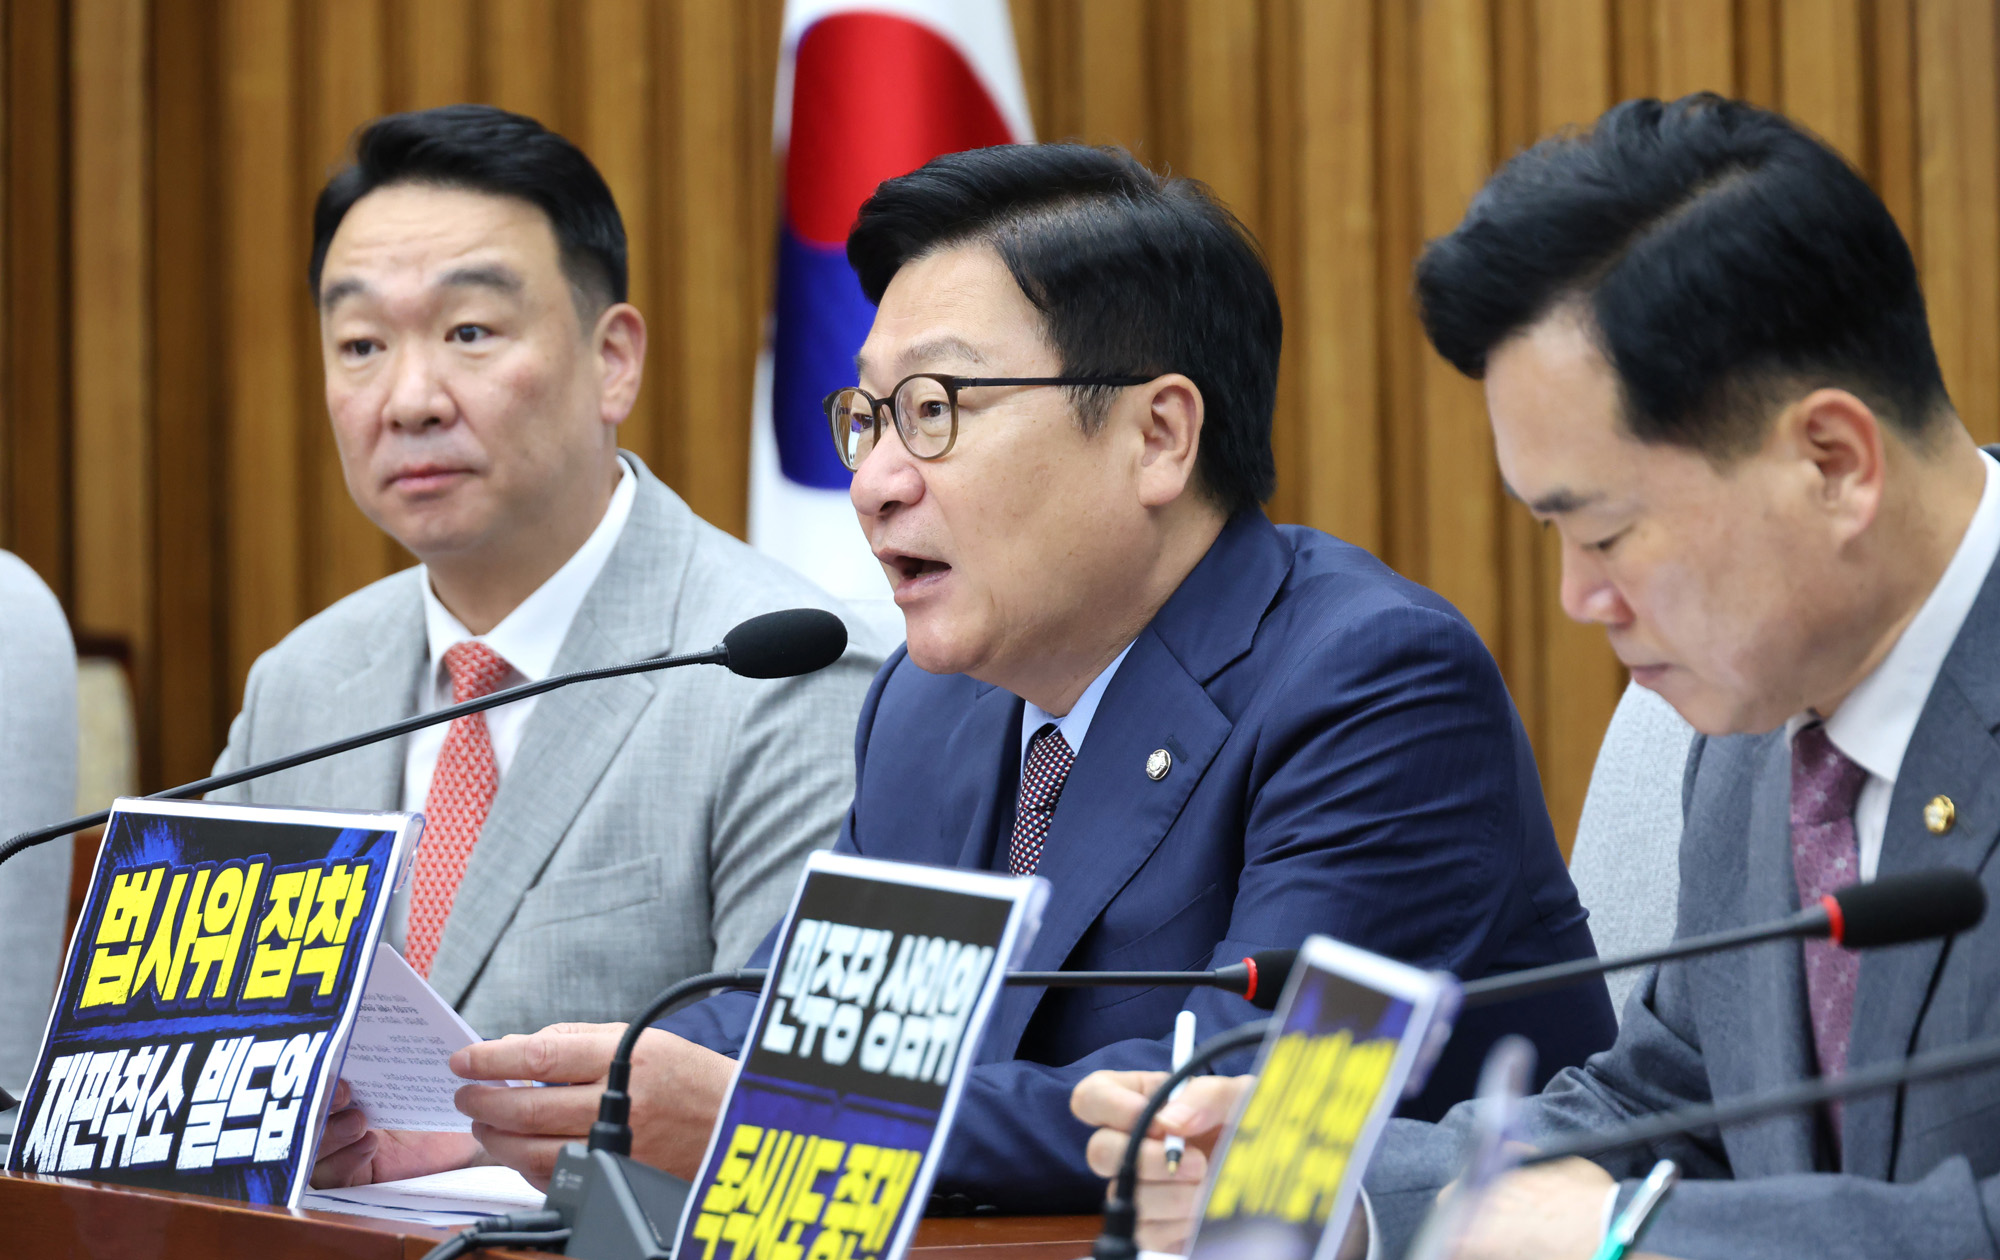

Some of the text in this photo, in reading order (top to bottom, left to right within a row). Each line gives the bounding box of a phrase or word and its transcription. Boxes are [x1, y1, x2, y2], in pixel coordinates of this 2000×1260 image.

[79, 862, 369, 1009] 법사위 집착
[761, 918, 995, 1086] 민주당 상임위
[22, 1031, 329, 1173] 재판취소 빌드업
